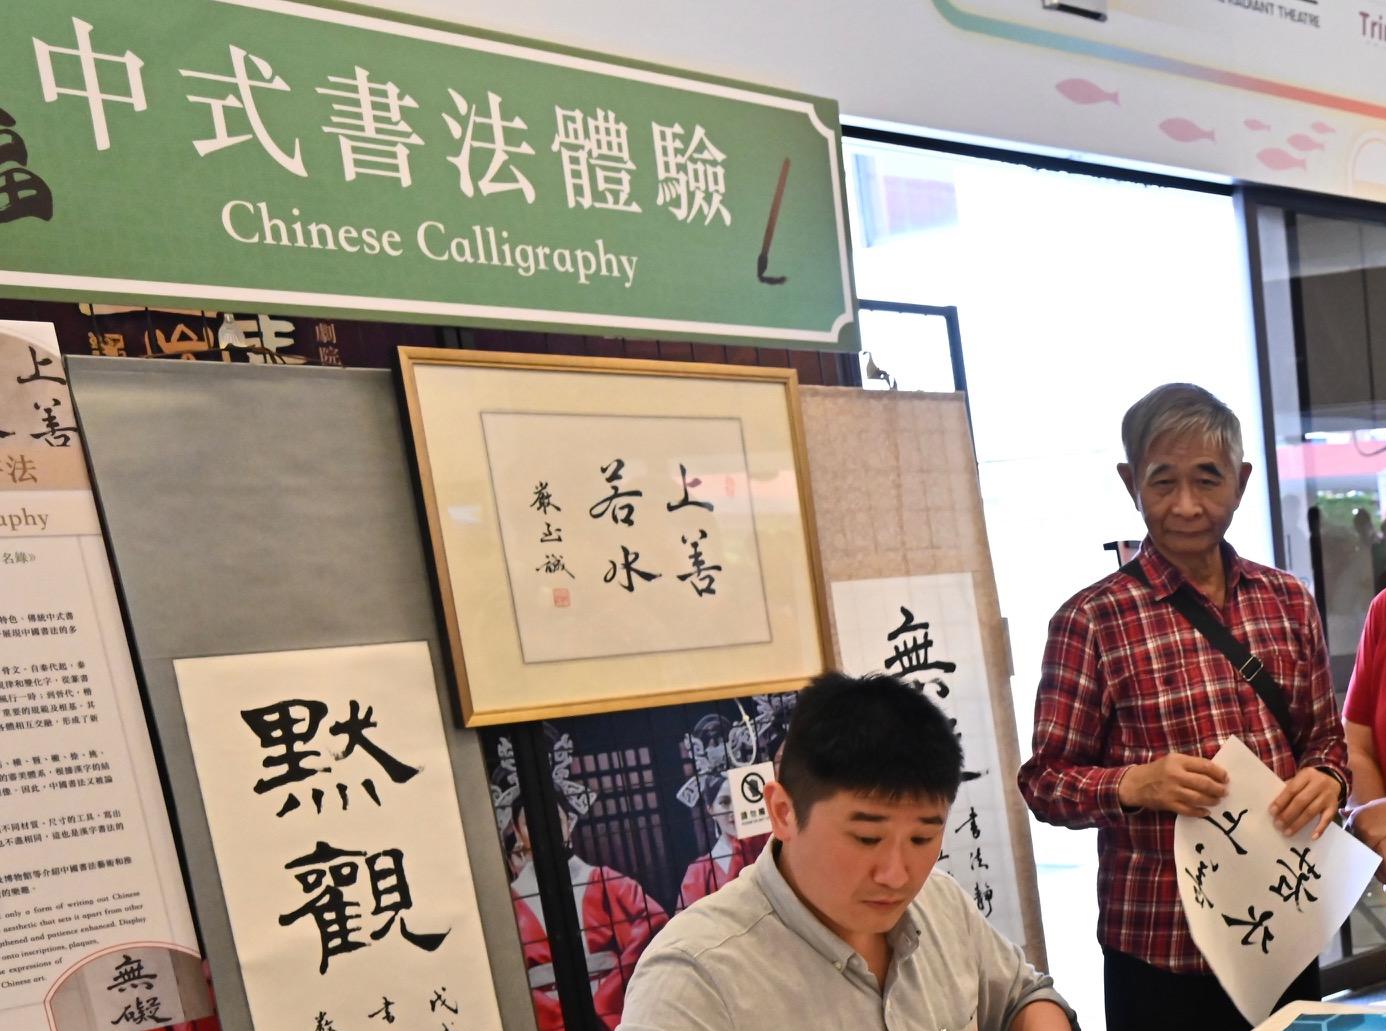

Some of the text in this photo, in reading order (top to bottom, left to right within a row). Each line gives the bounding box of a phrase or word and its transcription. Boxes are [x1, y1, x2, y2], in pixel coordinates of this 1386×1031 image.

[31, 17, 733, 227] 中式書法體驗
[221, 199, 639, 288] Chinese Calligraphy
[16, 346, 79, 448] 上善
[0, 455, 38, 484] 法
[589, 459, 662, 593] 若水
[666, 463, 723, 598] 上善
[0, 937, 28, 949] thened
[34, 906, 52, 914] form
[112, 891, 140, 901] Chinese
